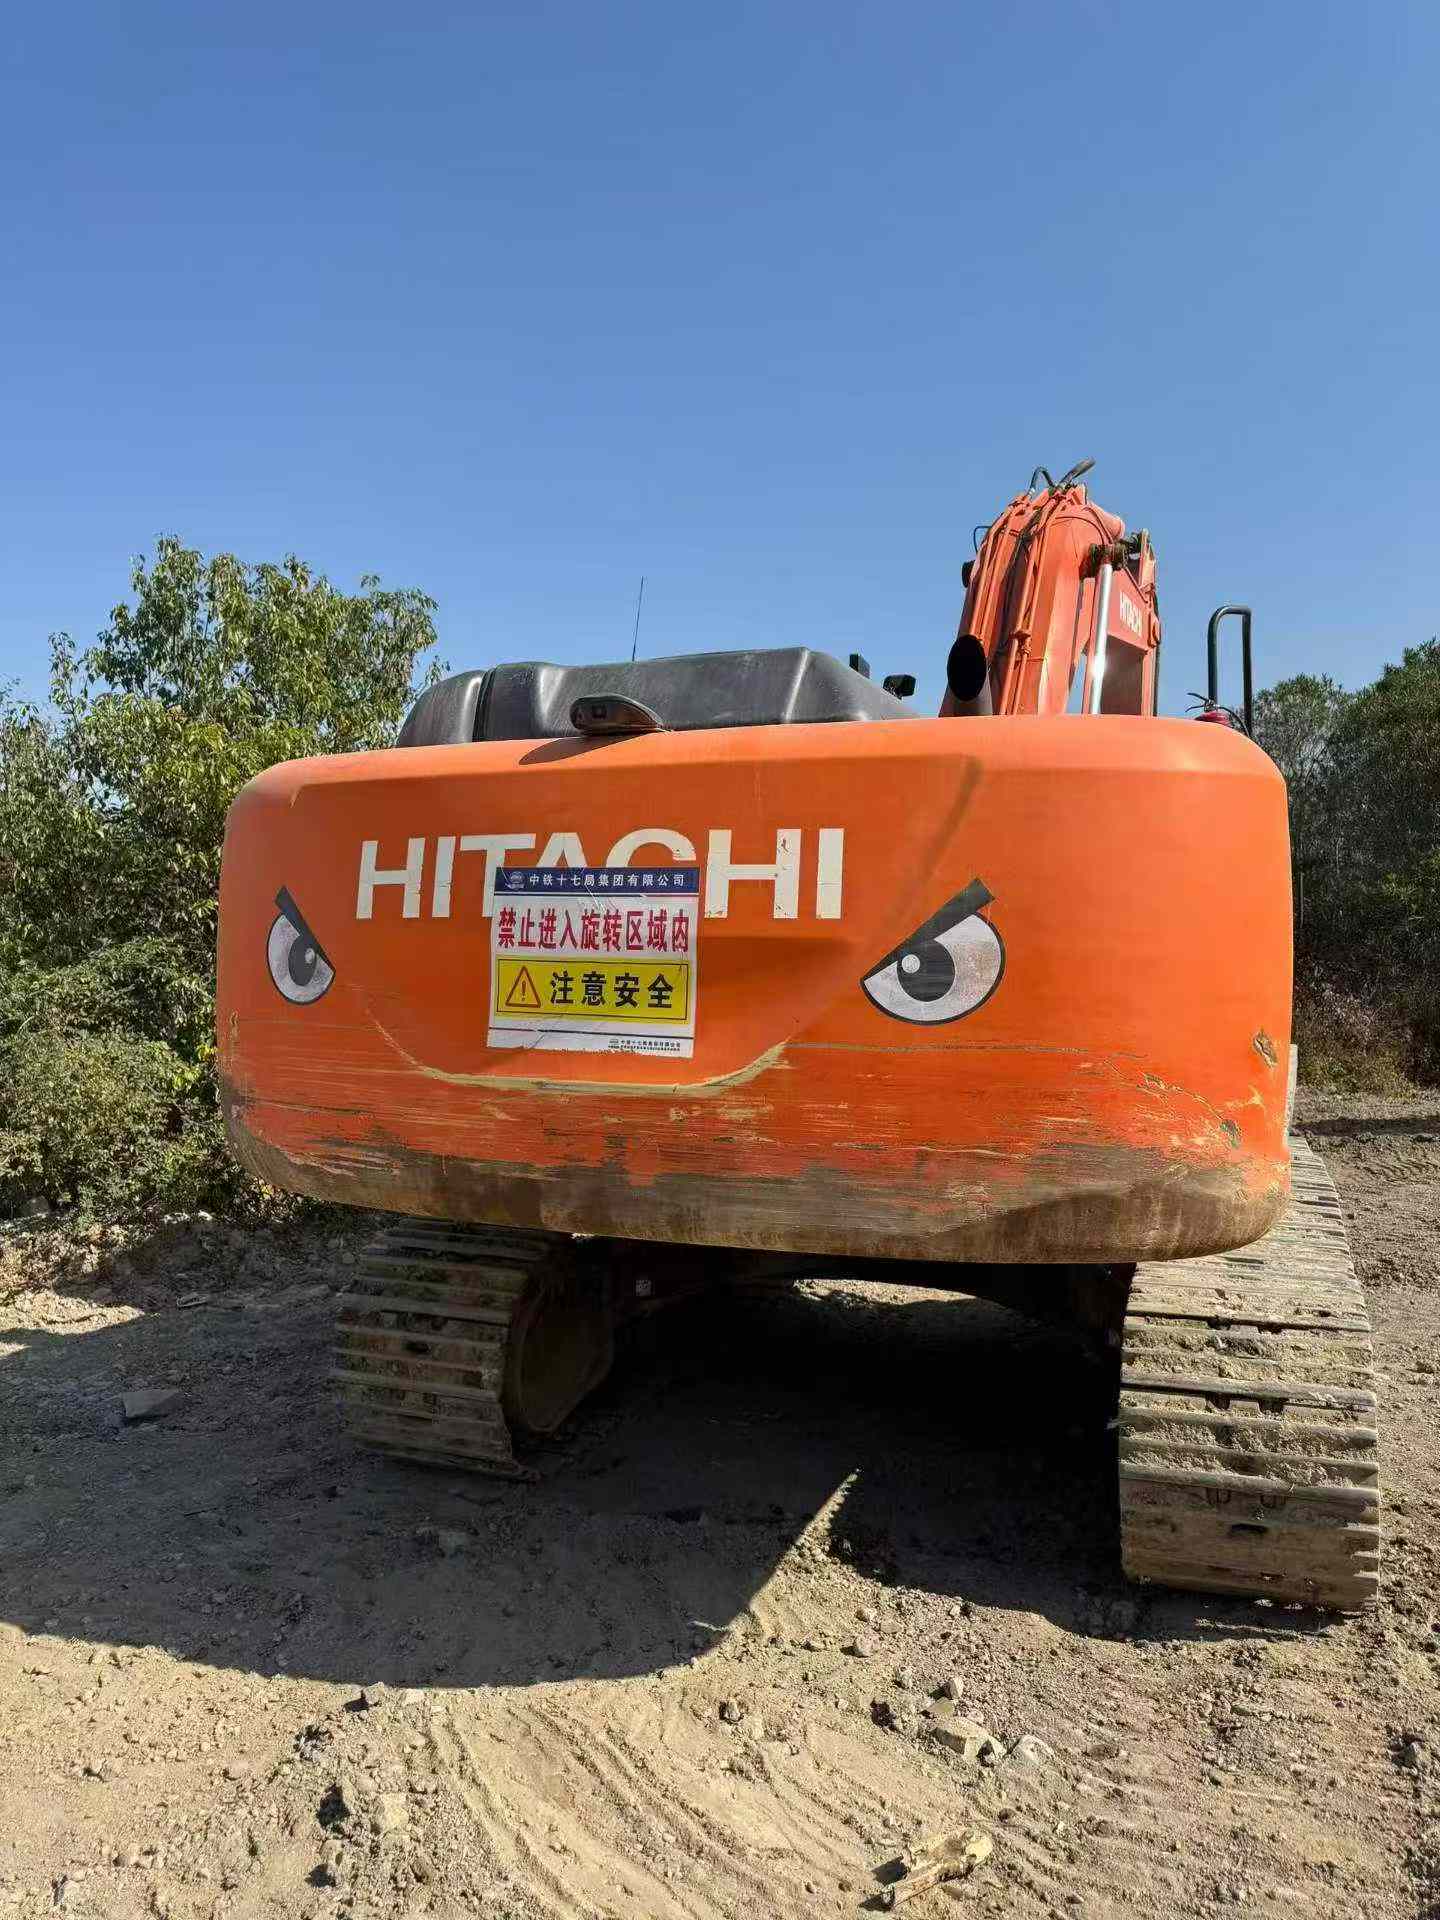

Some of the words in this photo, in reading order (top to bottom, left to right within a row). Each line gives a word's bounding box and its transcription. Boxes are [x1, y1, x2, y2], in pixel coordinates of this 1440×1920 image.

[529, 872, 685, 888] 中铁十七局集团有限公司
[498, 906, 690, 953] 禁止进入旋转区域内
[550, 970, 674, 1009] 注意安全
